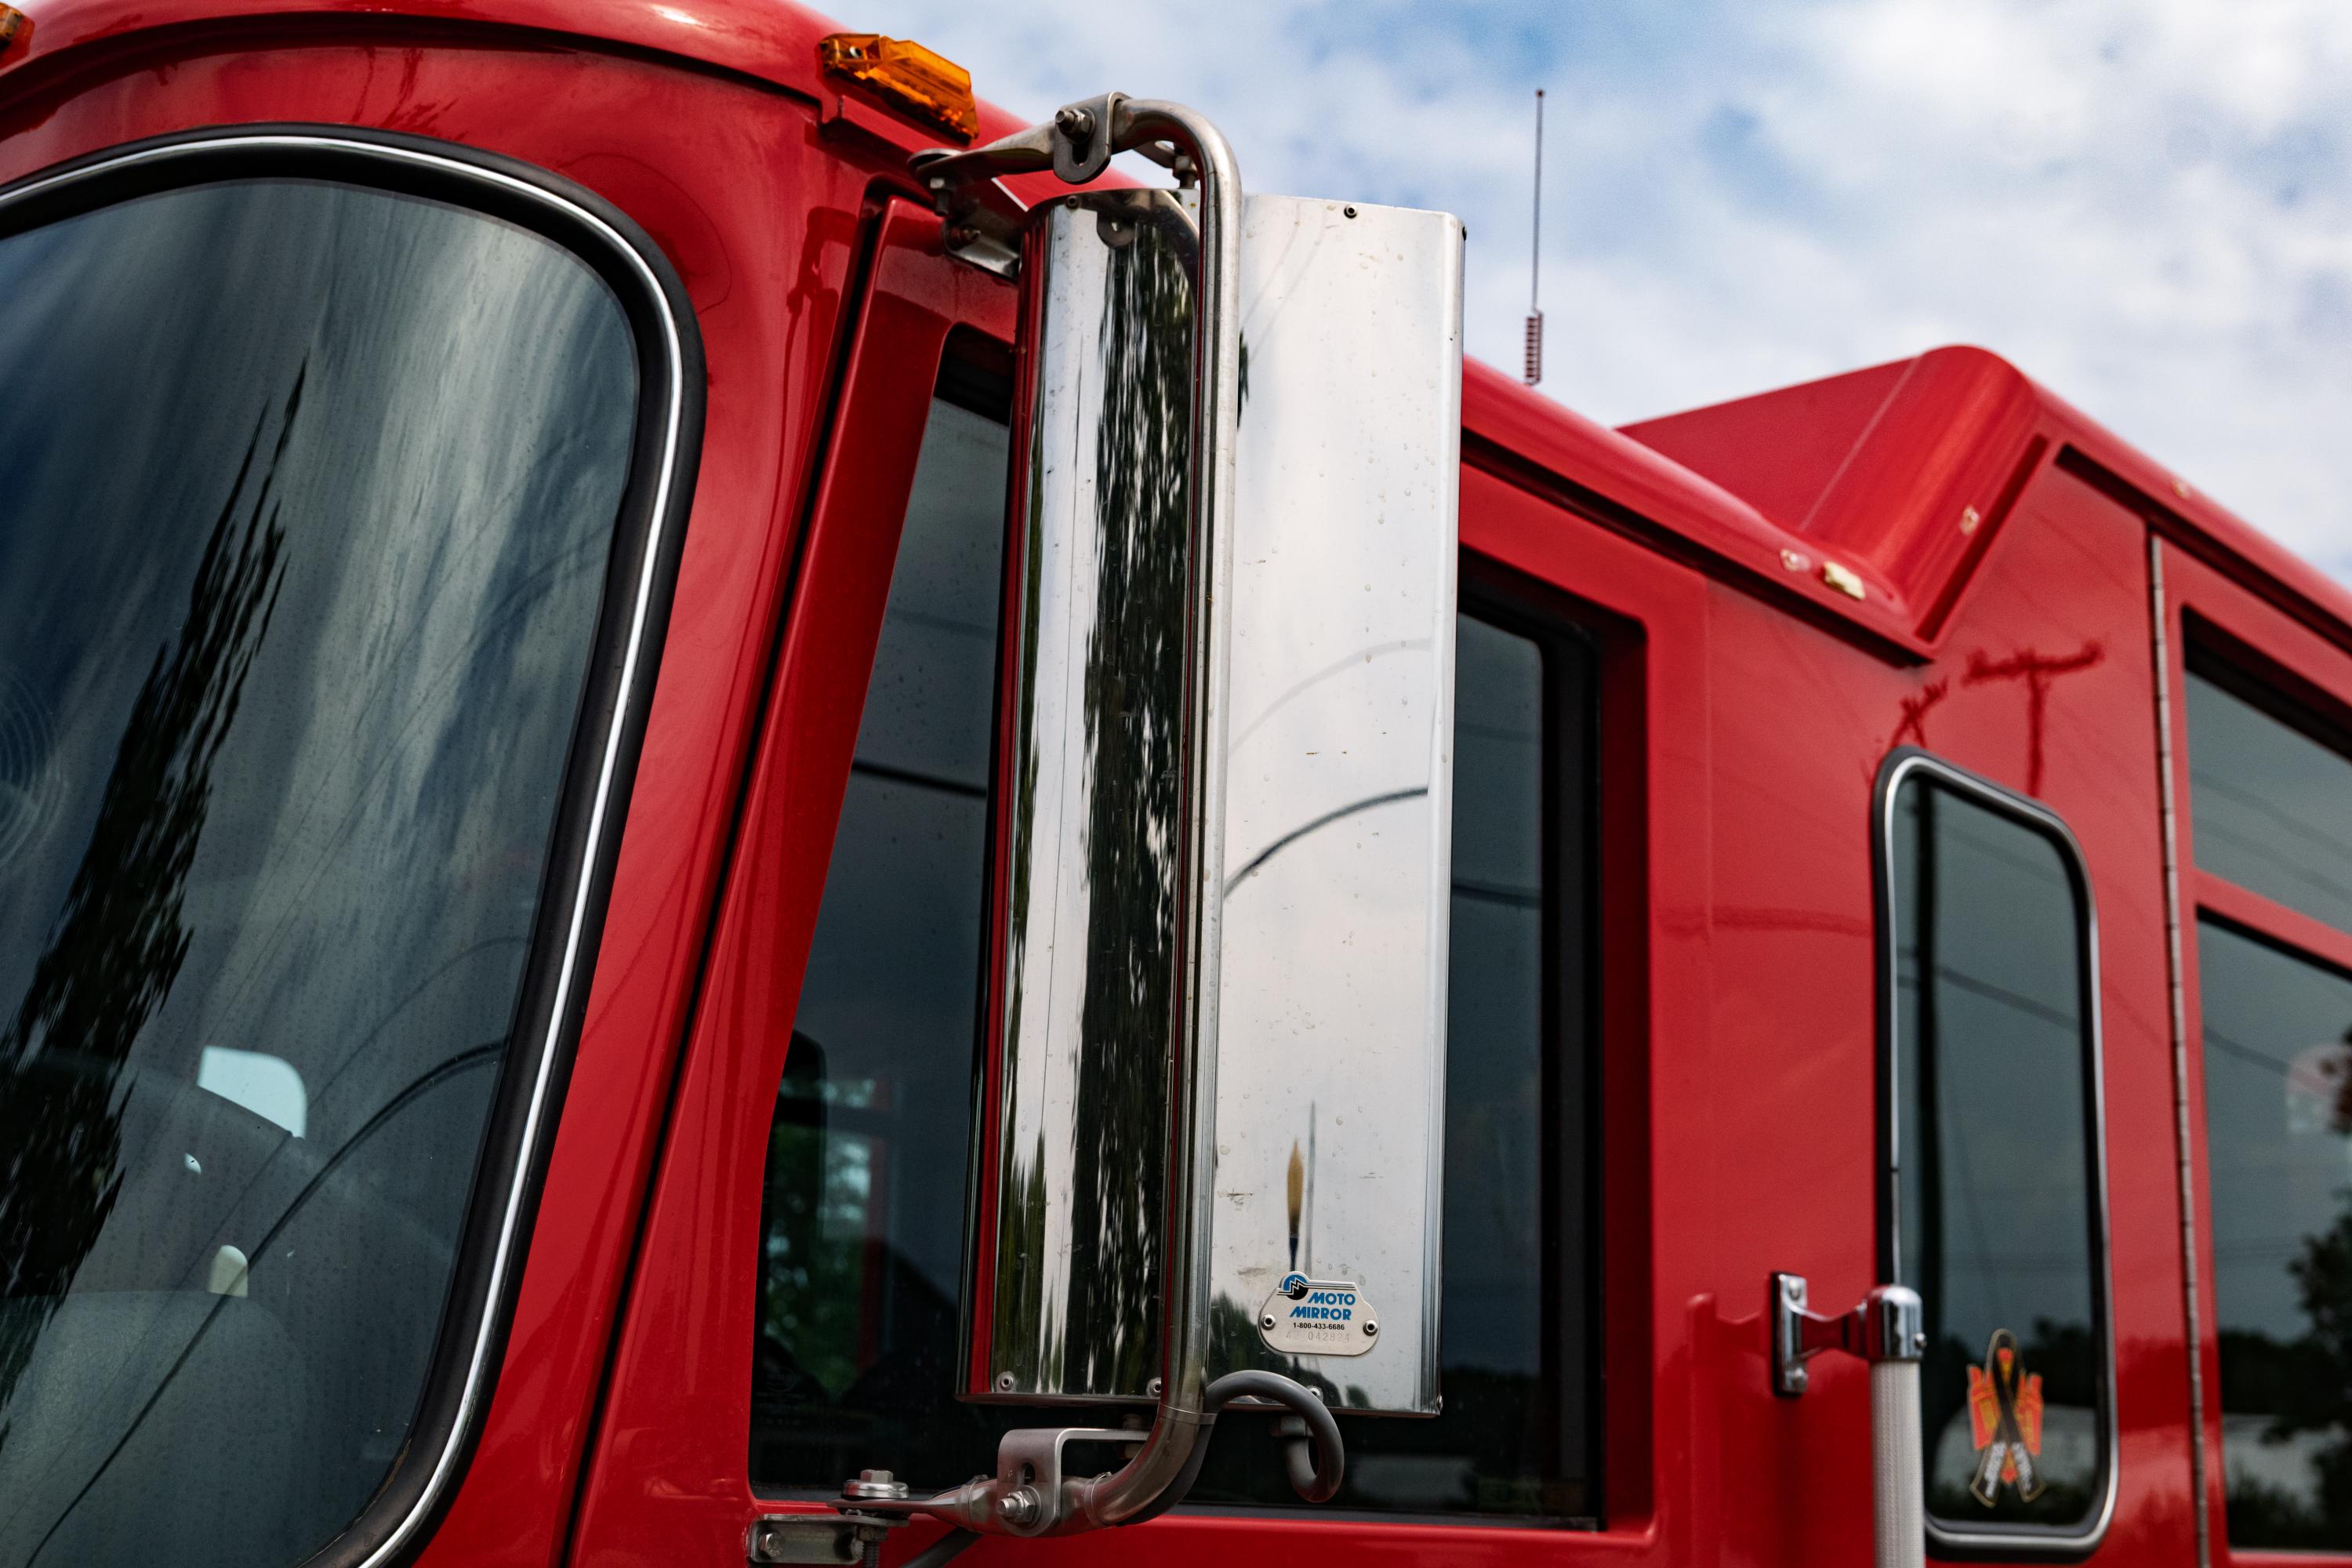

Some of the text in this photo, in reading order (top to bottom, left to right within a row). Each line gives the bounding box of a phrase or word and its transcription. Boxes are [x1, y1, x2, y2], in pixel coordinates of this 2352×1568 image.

[1307, 1292, 1356, 1306] MOTO
[1289, 1306, 1352, 1320] MIRROR
[1293, 1322, 1345, 1330] 1-800-433-6686
